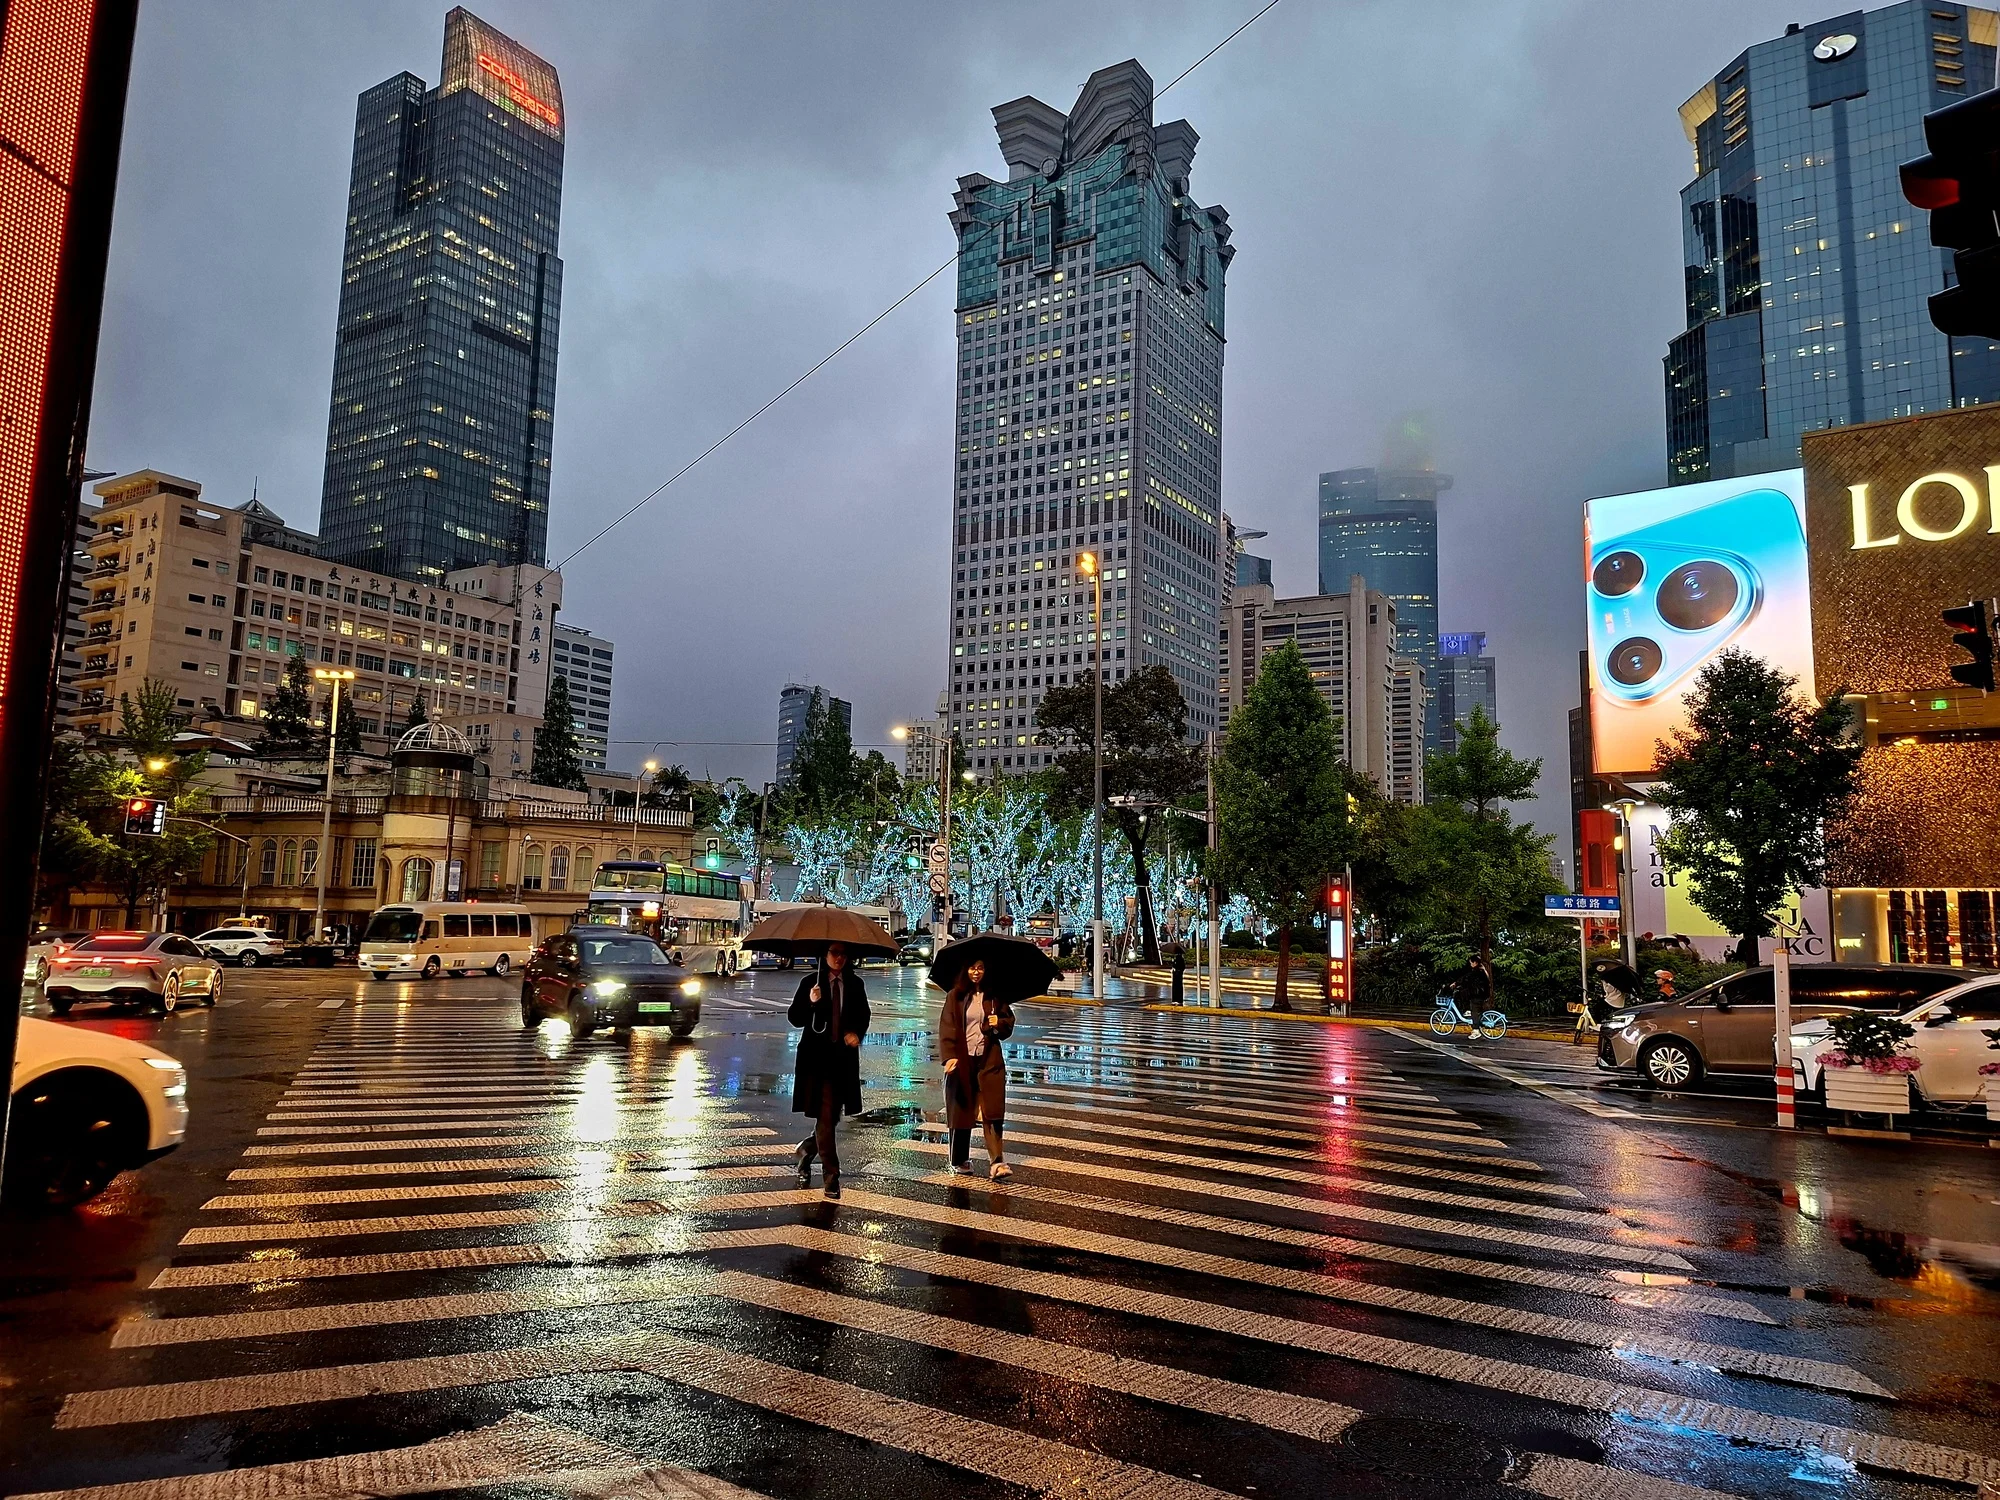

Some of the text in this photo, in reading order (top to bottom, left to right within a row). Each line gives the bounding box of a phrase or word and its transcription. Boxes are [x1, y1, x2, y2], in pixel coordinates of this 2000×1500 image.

[1650, 867, 1678, 888] at
[1563, 897, 1600, 909] 常德路
